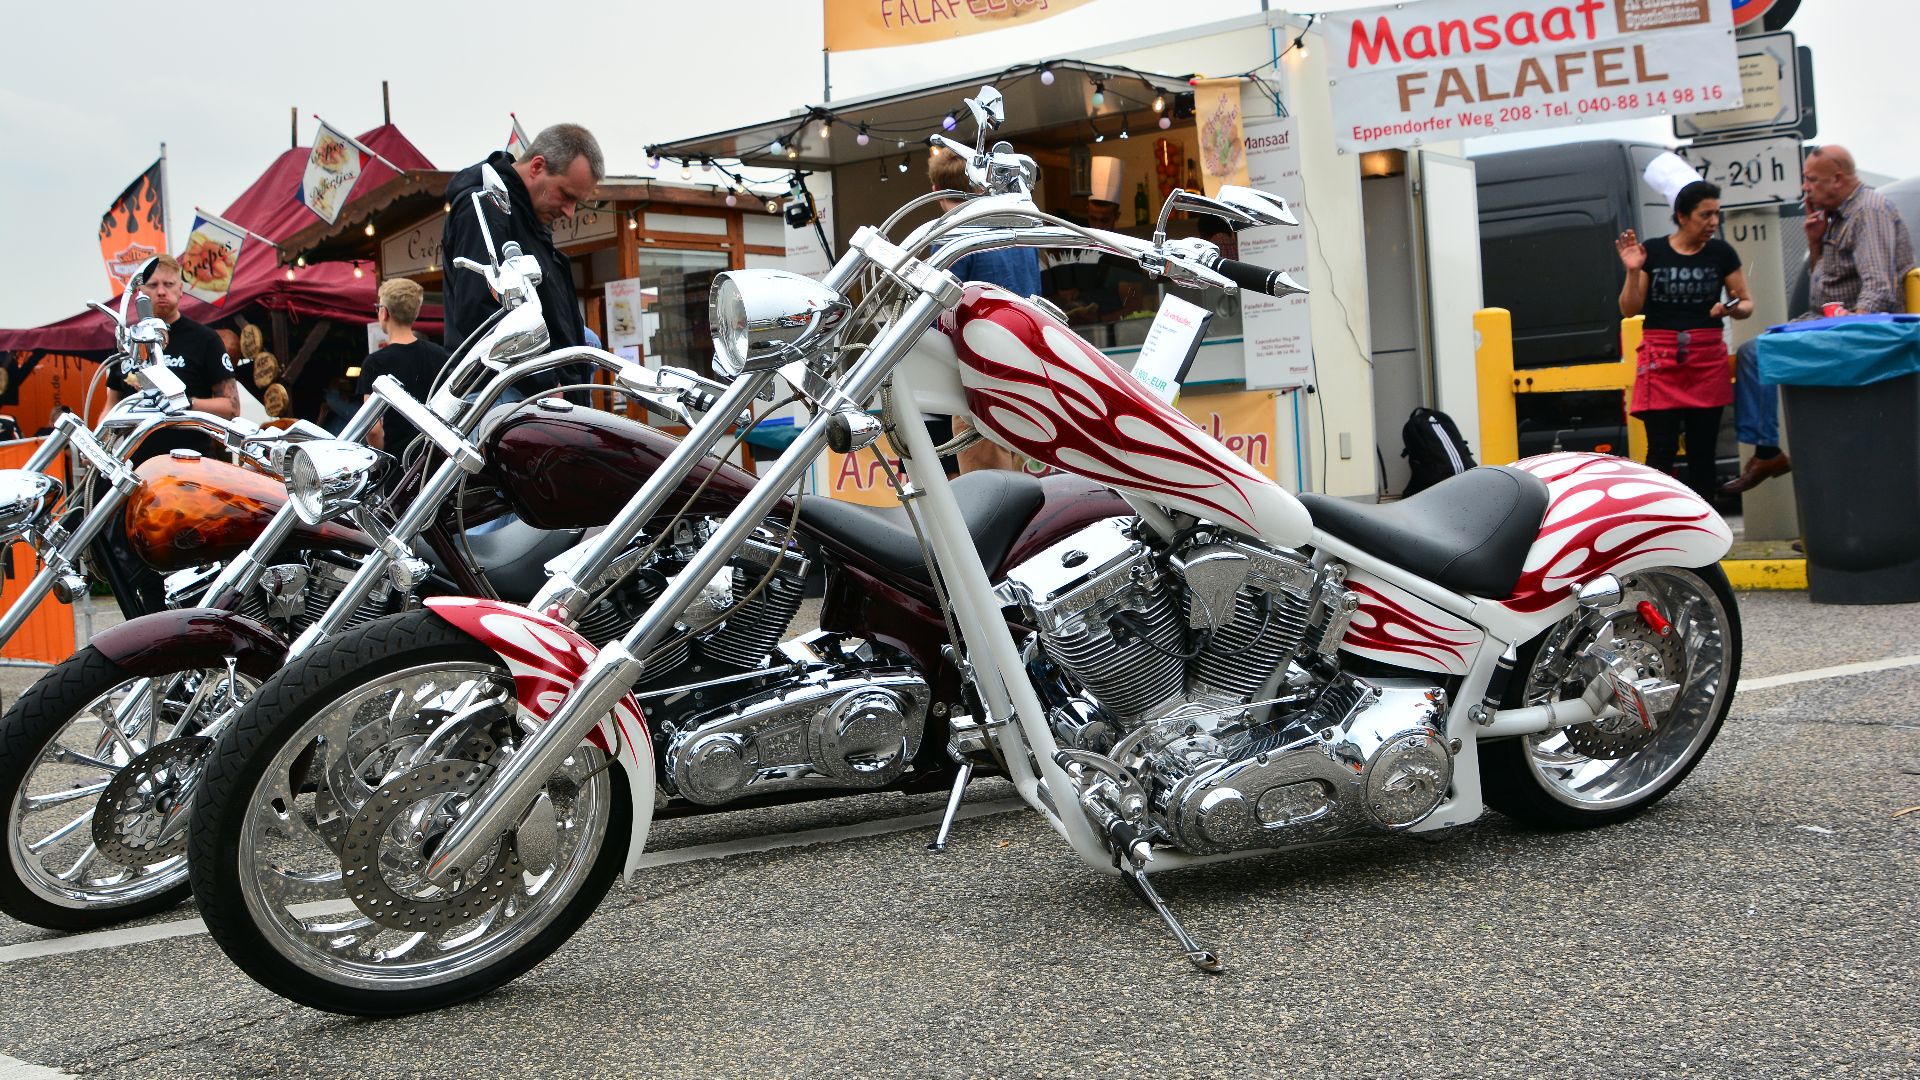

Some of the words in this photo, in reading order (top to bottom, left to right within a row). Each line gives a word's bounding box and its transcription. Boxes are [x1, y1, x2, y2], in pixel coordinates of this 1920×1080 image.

[1397, 44, 1669, 112] FALAFEL
[1352, 117, 1451, 141] Eppendorfer
[1458, 111, 1494, 128] Weg
[1543, 102, 1573, 118] Tel.
[1578, 95, 1639, 114] 040-88
[1645, 90, 1667, 107] 14
[1672, 87, 1695, 104] 98
[1701, 84, 1723, 101] 16
[407, 229, 444, 265] Crêp
[551, 210, 598, 240] ertjes
